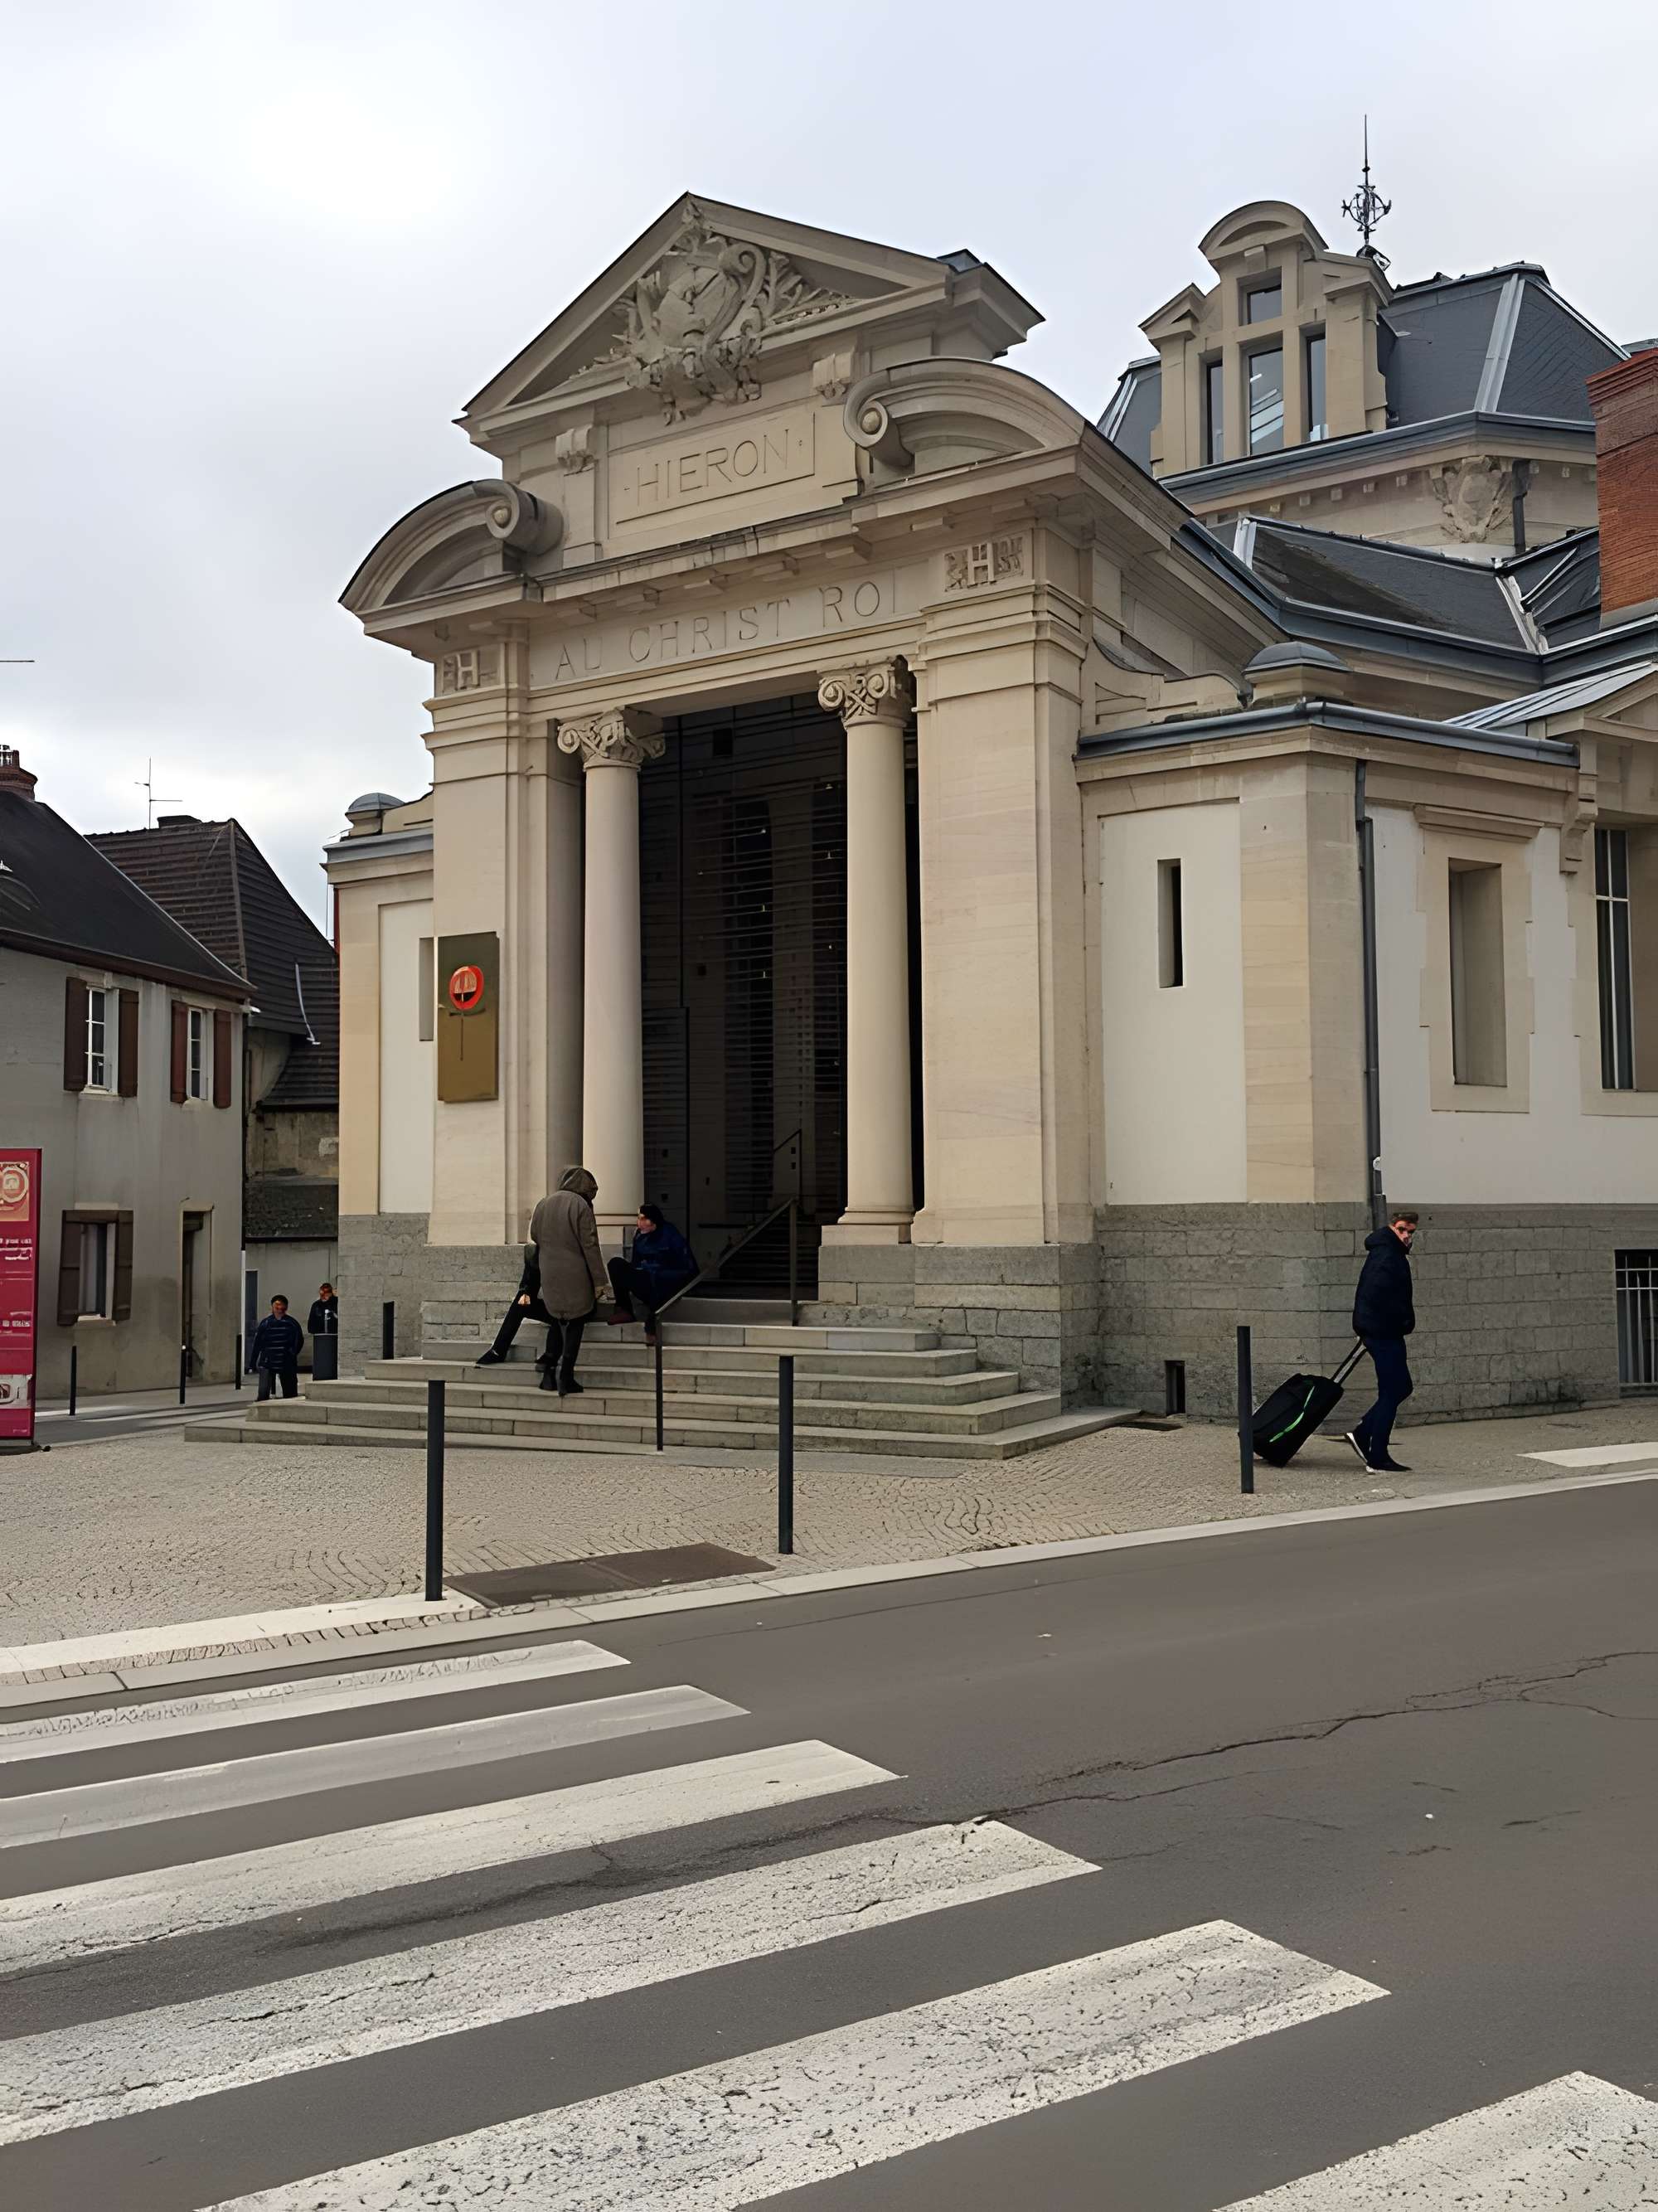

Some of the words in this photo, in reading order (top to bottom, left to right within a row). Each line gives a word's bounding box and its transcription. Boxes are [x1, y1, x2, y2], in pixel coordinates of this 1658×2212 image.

[636, 428, 789, 507] HIERON
[555, 636, 604, 682] AU
[628, 598, 791, 663] CHRIST
[817, 565, 896, 628] ROI
